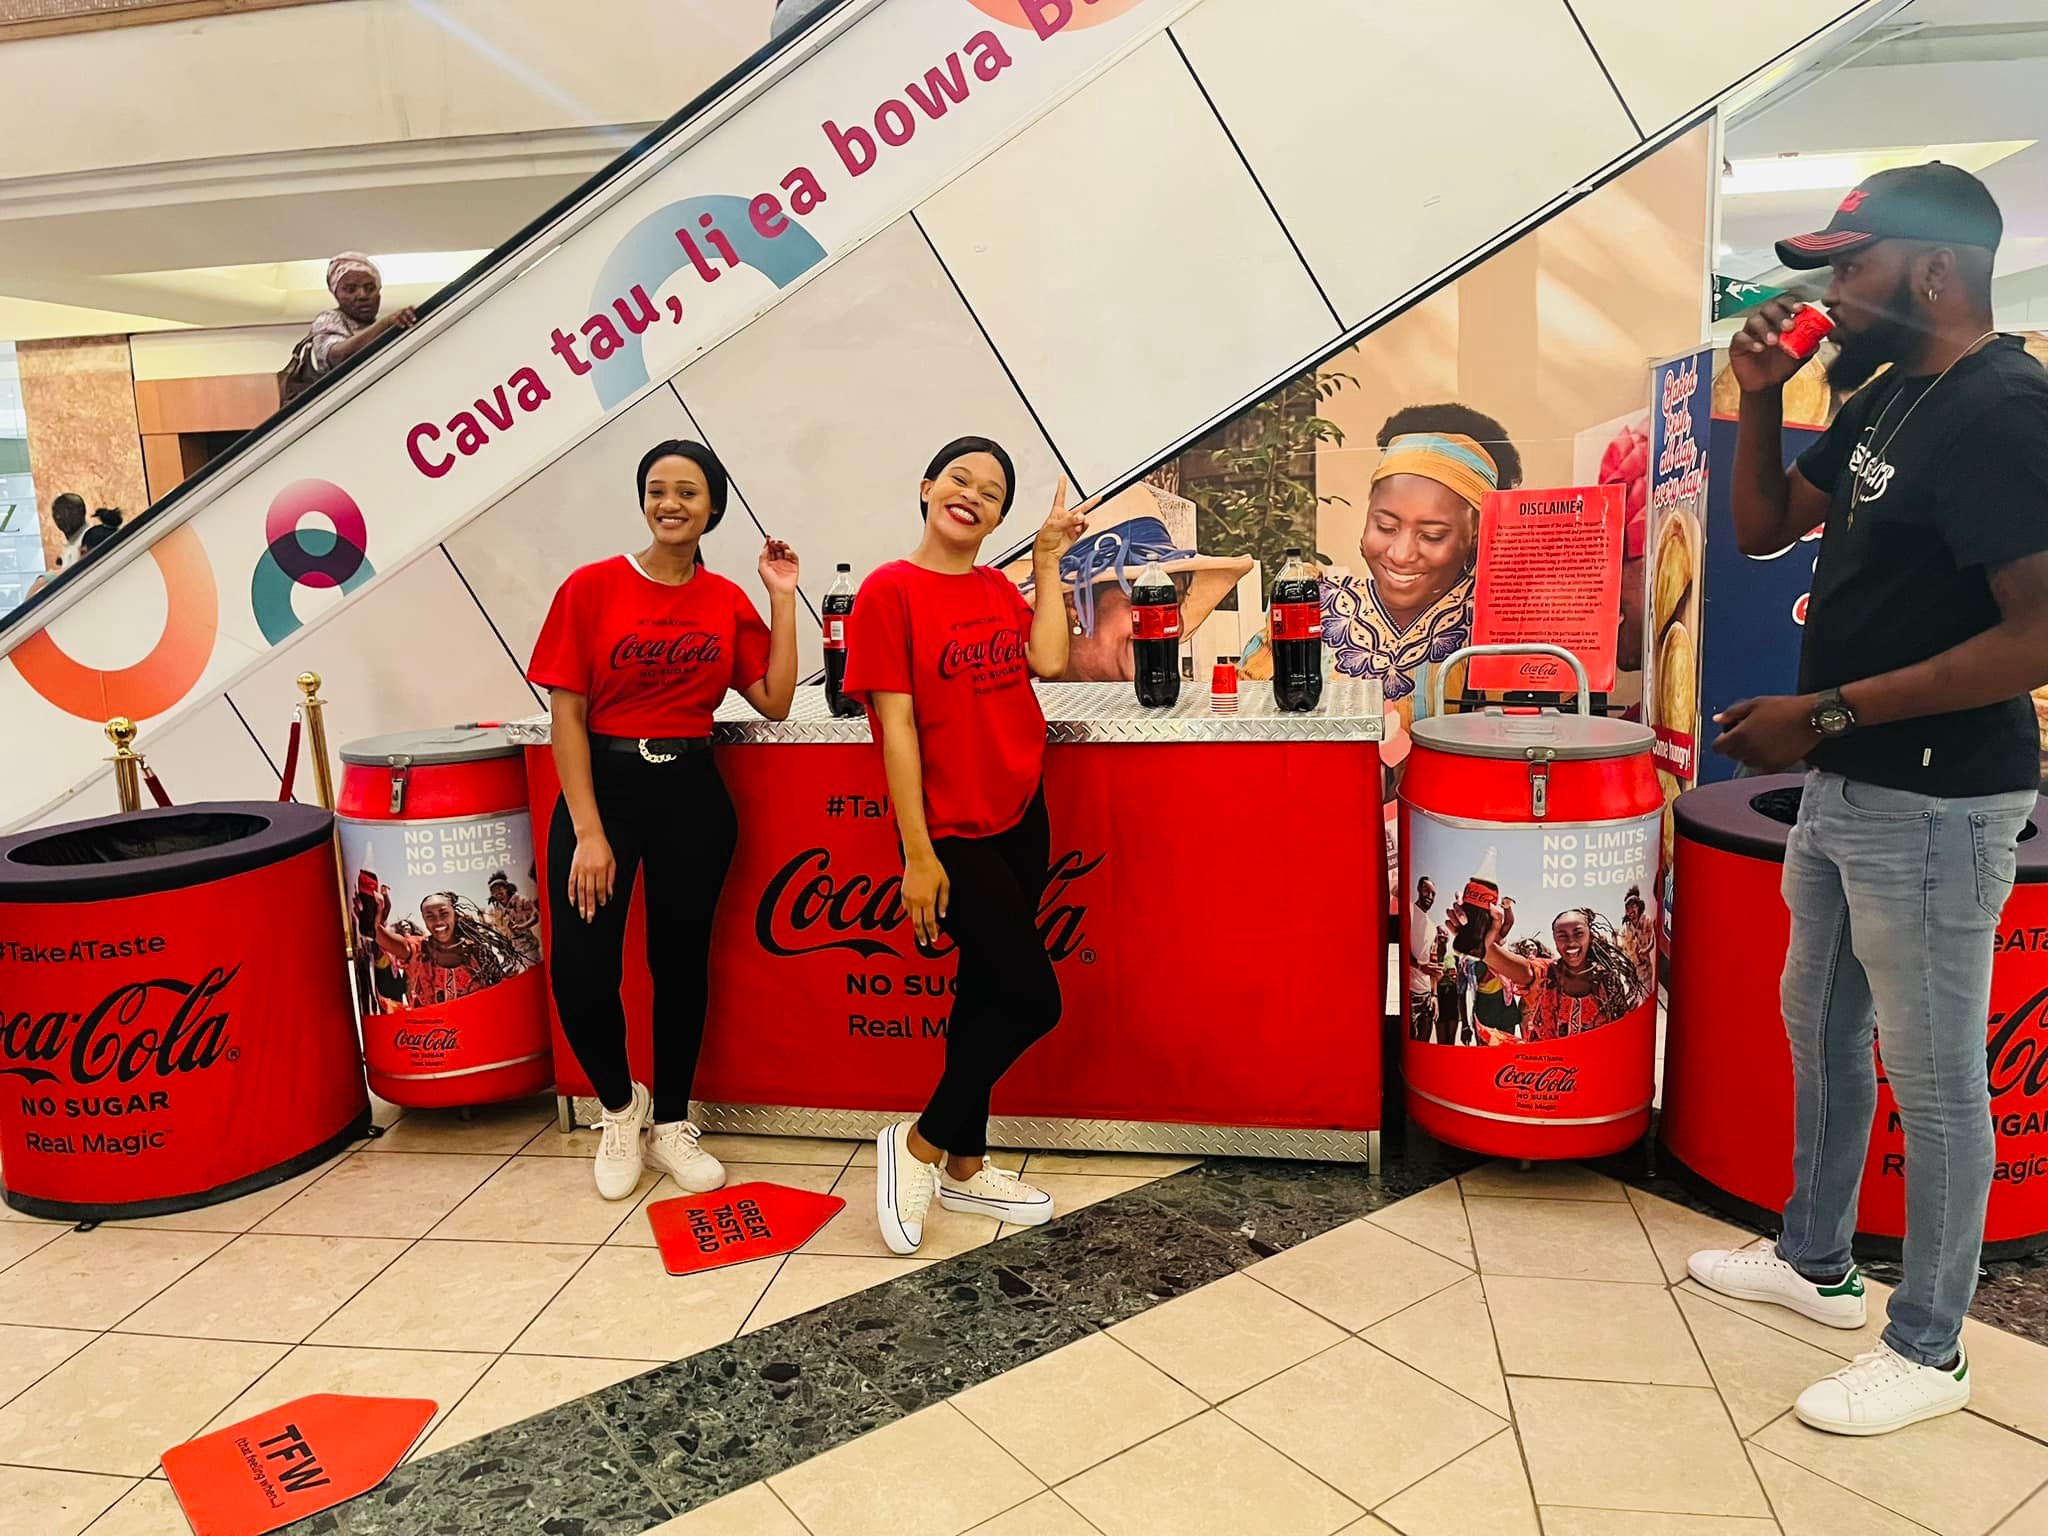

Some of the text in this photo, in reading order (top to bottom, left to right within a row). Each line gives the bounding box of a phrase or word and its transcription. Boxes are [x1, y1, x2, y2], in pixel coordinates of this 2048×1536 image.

[406, 0, 1099, 479] Cava tau, li ea bowa B
[1662, 354, 1698, 417] Baked
[1520, 500, 1584, 516] DISCLAIMER
[610, 632, 721, 670] Coca-Cola
[404, 821, 511, 844] NO LIMITS.
[1543, 827, 1647, 851] NO LIMITS.
[405, 837, 511, 860] NO RULES.
[1543, 846, 1646, 869] NO RULES.
[407, 853, 516, 876] NO SUGAR.
[1542, 864, 1648, 889] NO SUGAR.
[847, 974, 892, 996] NO
[394, 1028, 460, 1051] Coca-Cola
[849, 1015, 912, 1038] Real
[1495, 1065, 1579, 1092] Coca-Cola
[21, 1091, 170, 1118] NO SUGAR
[26, 1130, 165, 1156] Real Magic
[1993, 1153, 2048, 1184] agic
[685, 1208, 720, 1253] AHEAD
[712, 1204, 745, 1244] TASTE
[737, 1199, 772, 1239] GREAT
[258, 1424, 331, 1492] TFW
